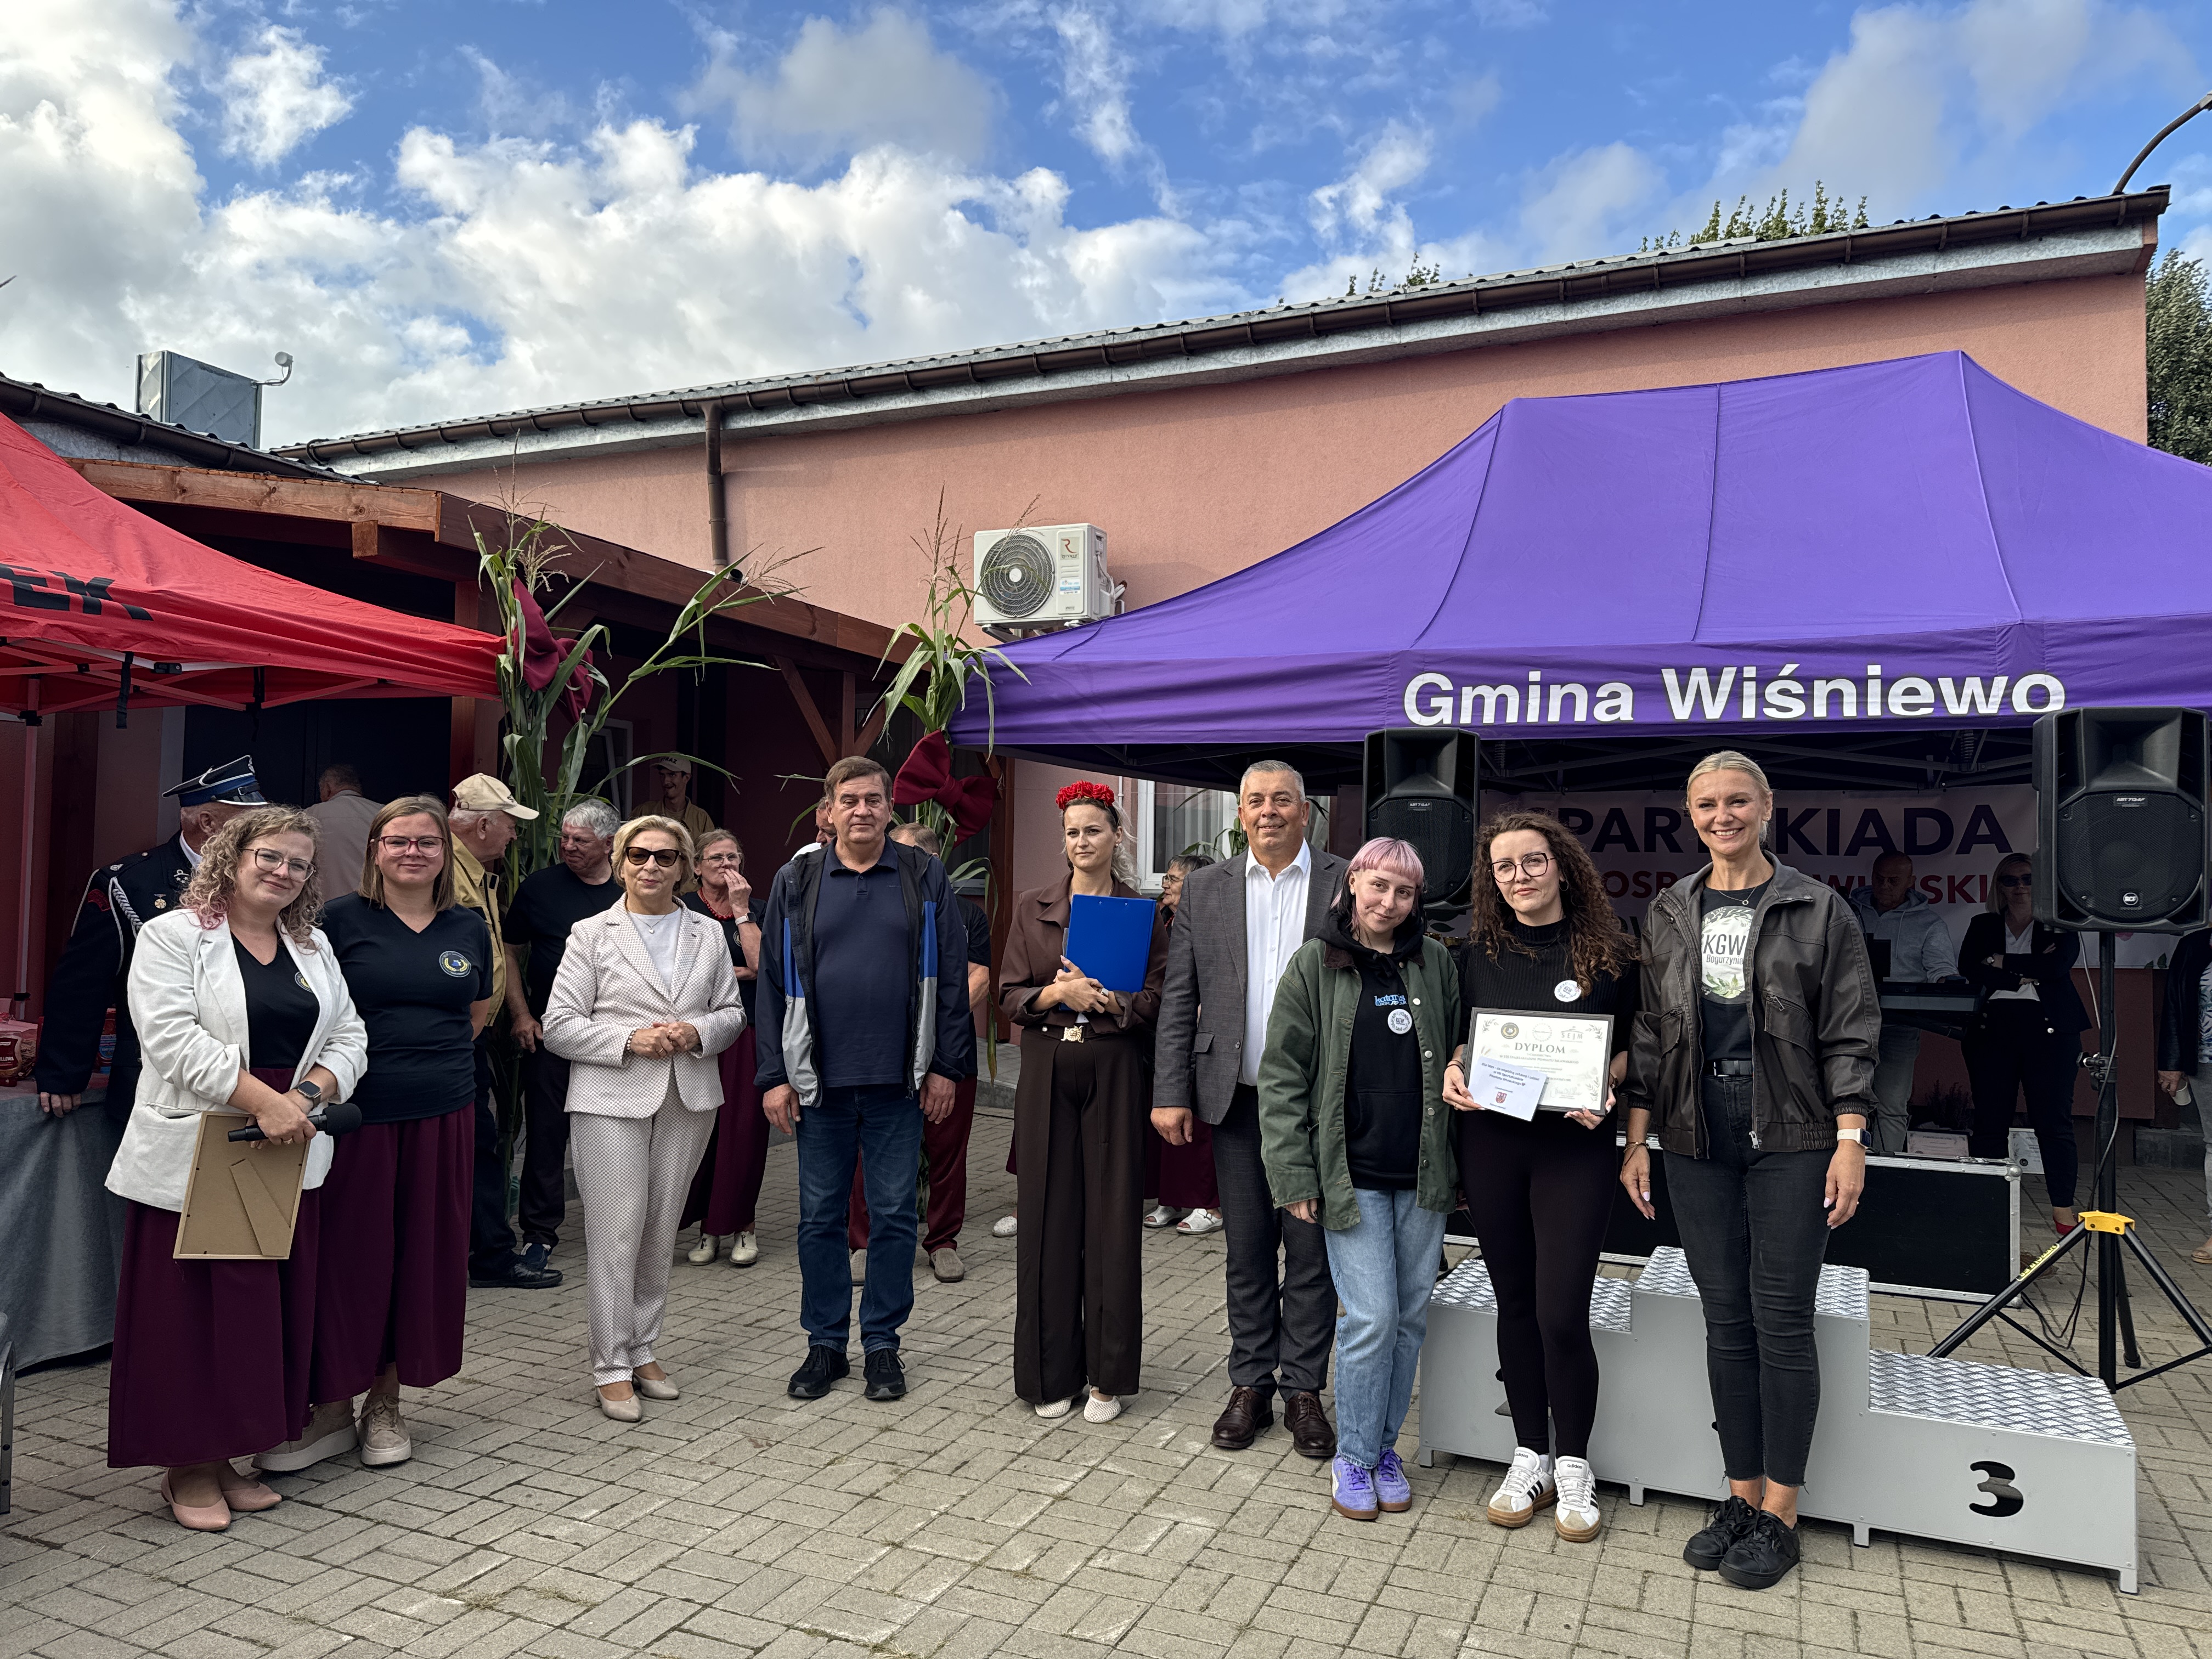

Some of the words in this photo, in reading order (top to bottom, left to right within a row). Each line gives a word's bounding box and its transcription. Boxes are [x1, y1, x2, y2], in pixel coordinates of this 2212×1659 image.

[1403, 670, 1634, 726] Gmina
[1661, 663, 2066, 720] Wiśniewo
[1528, 804, 2013, 856] PARKIADA
[1703, 934, 1746, 956] KGW
[1514, 1042, 1565, 1054] DYPLOM
[1561, 1032, 1583, 1040] SEJM
[1969, 1460, 2024, 1517] 3
